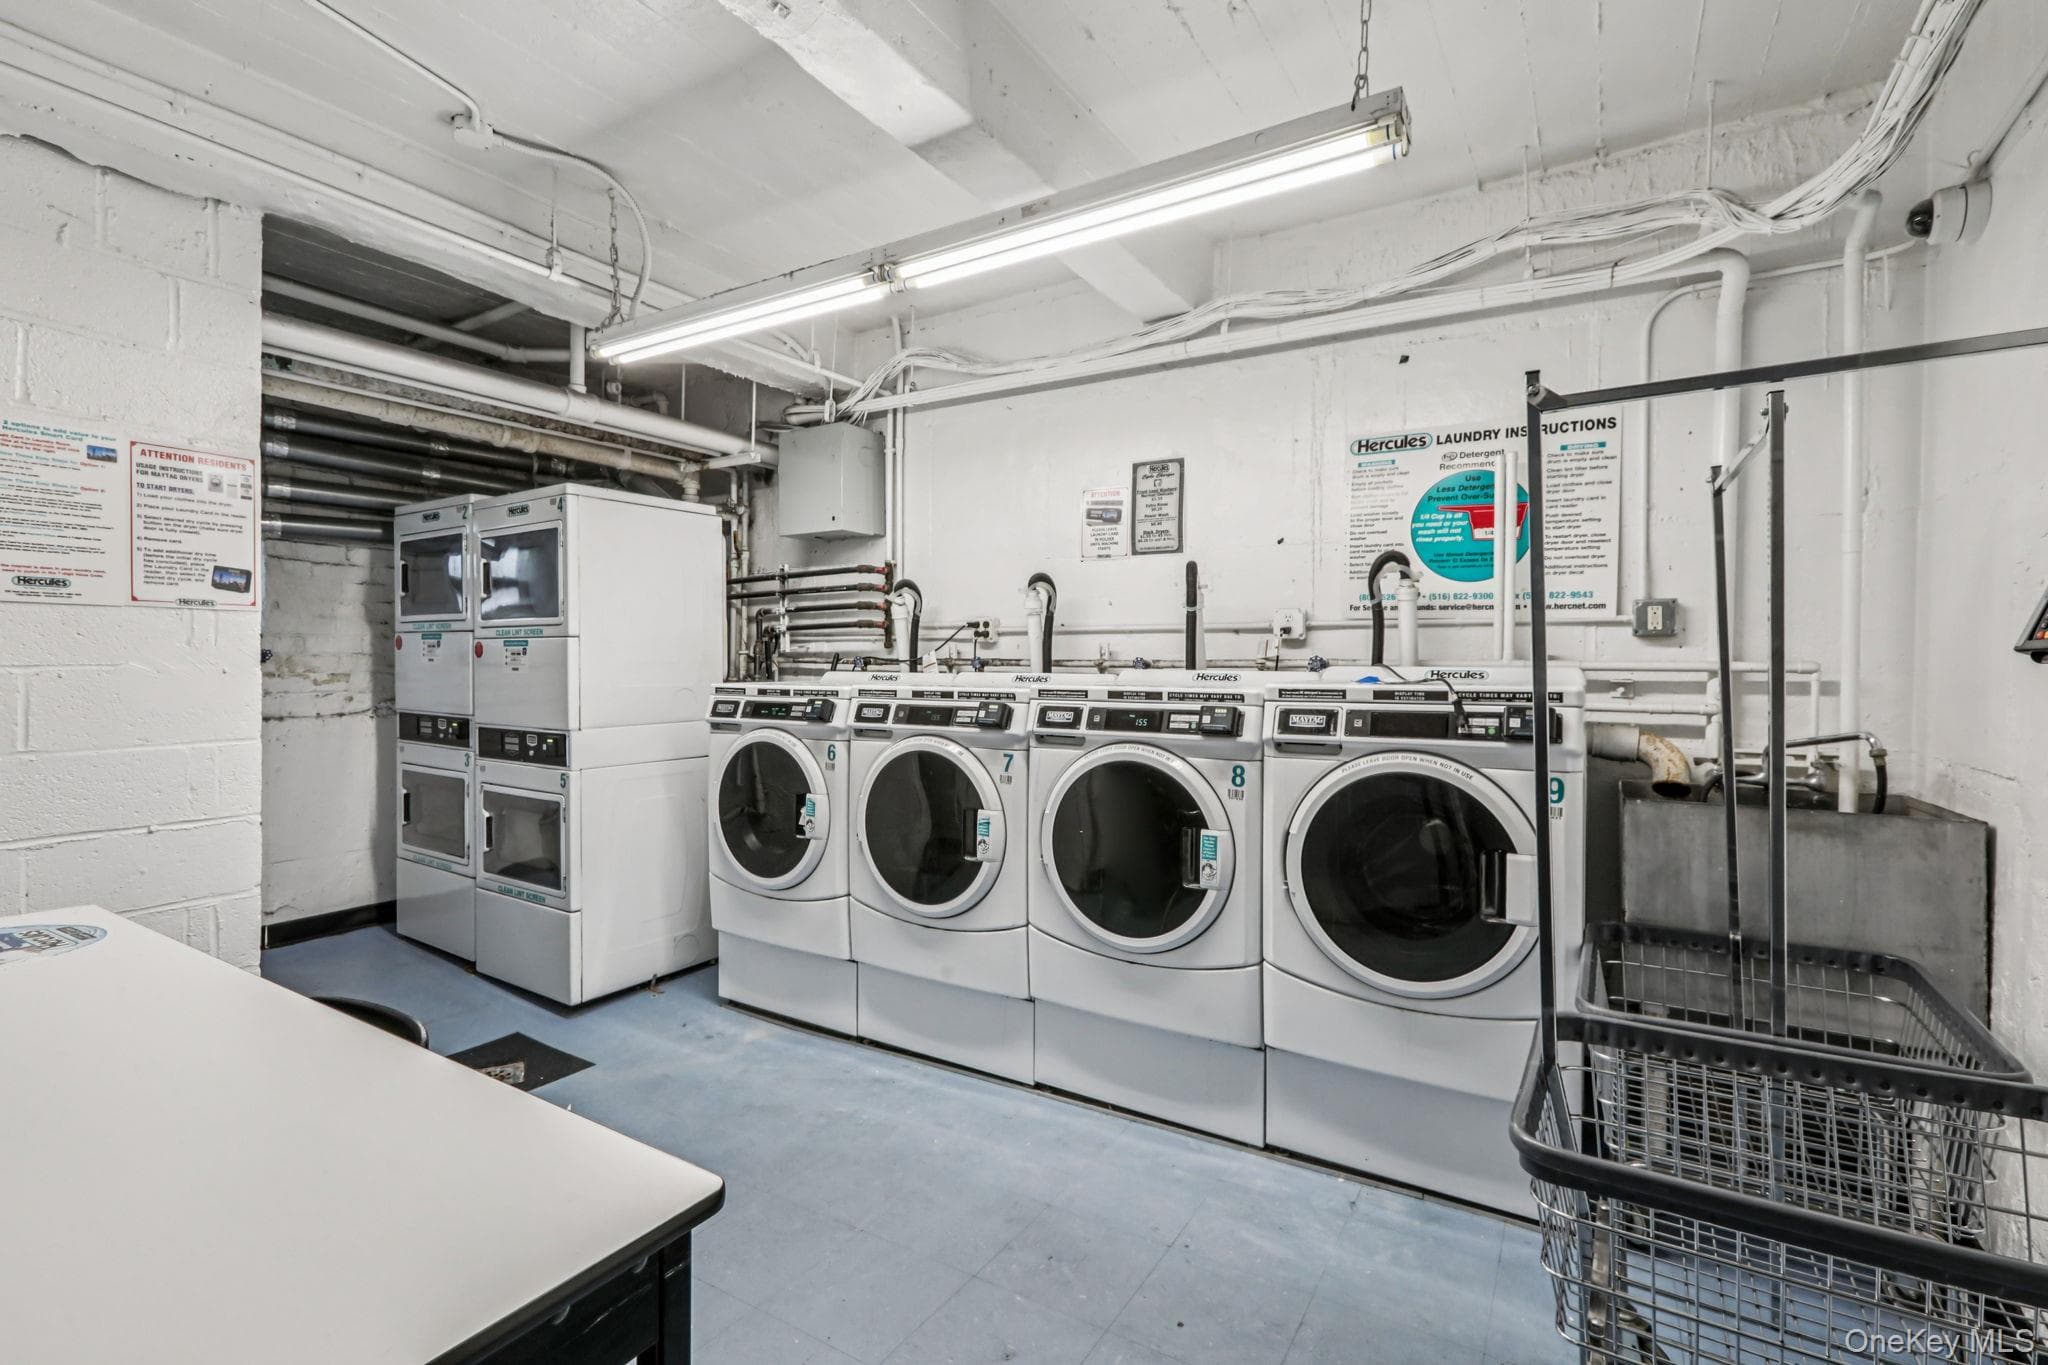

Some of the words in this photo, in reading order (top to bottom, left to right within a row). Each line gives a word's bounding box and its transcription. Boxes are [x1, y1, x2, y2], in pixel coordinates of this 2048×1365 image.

[1436, 429, 1500, 445] LAUNDRY
[1506, 417, 1617, 438] INSRUCTIONS
[1357, 435, 1427, 453] Hercules
[140, 449, 195, 463] ATTENTION
[197, 457, 247, 471] RESIDENTS
[1459, 449, 1504, 460] Detergent
[151, 471, 177, 480] MAYTAG
[179, 475, 203, 483] DRYERS
[159, 466, 203, 476] INSTRUCTIONS
[146, 483, 166, 491] START
[508, 506, 529, 514] Hercules
[557, 497, 563, 512] 4
[462, 505, 468, 519] 2
[17, 576, 68, 588] Hercules
[1429, 592, 1450, 600] (516)
[1549, 591, 1594, 599] 822-9543
[1014, 675, 1048, 683] Hercules
[1196, 673, 1238, 682] Hercules
[1430, 670, 1485, 679] Hercules
[827, 744, 836, 760] 6
[464, 753, 470, 767] 3
[1003, 754, 1014, 772] 7
[1341, 762, 1361, 773] PLEASE
[1362, 757, 1380, 766] LEAVE
[1420, 758, 1438, 766] WHEN
[1440, 762, 1452, 770] NOT
[1461, 772, 1474, 780] USE
[560, 773, 567, 788] 5
[1231, 765, 1245, 787] 8
[1549, 777, 1565, 804] 9
[513, 889, 524, 897] LINT
[526, 891, 546, 903] SCREEN
